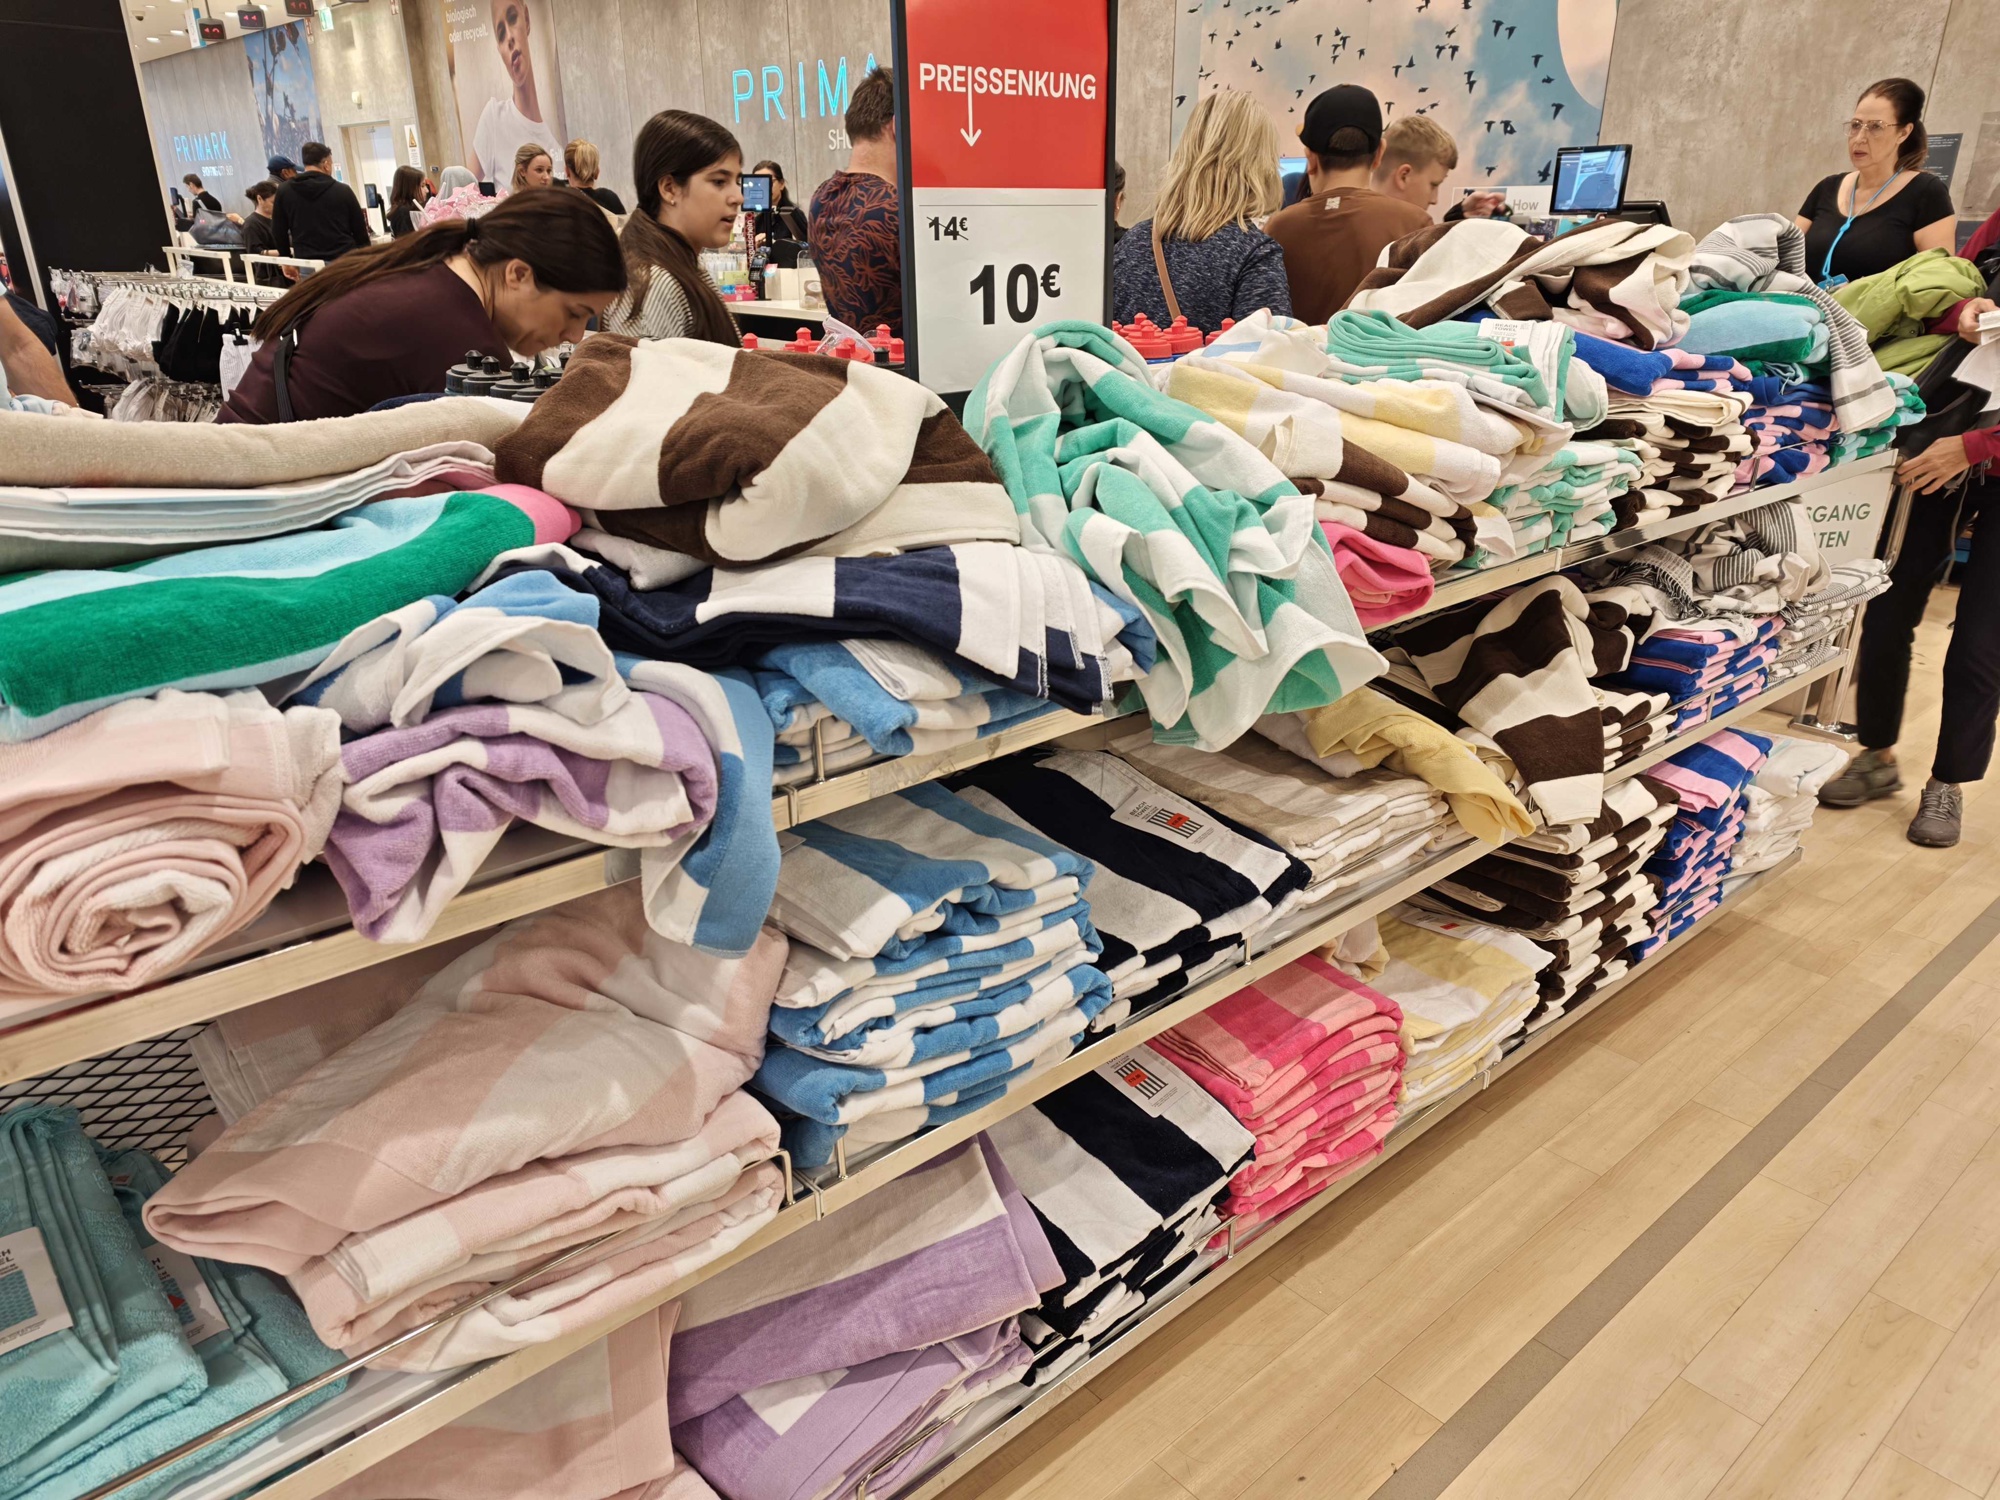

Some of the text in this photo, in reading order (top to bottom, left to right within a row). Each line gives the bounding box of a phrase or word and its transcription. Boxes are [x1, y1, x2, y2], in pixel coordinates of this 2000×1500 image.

[446, 4, 477, 23] biologisch
[449, 29, 462, 43] oder
[919, 63, 1097, 100] PREISSENKUNG
[173, 130, 232, 163] PRIMARK
[1512, 198, 1539, 211] How
[970, 263, 1061, 325] 10€
[1814, 530, 1850, 549] TEN
[1129, 801, 1147, 816] BEACH
[1134, 804, 1152, 818] TOWEL
